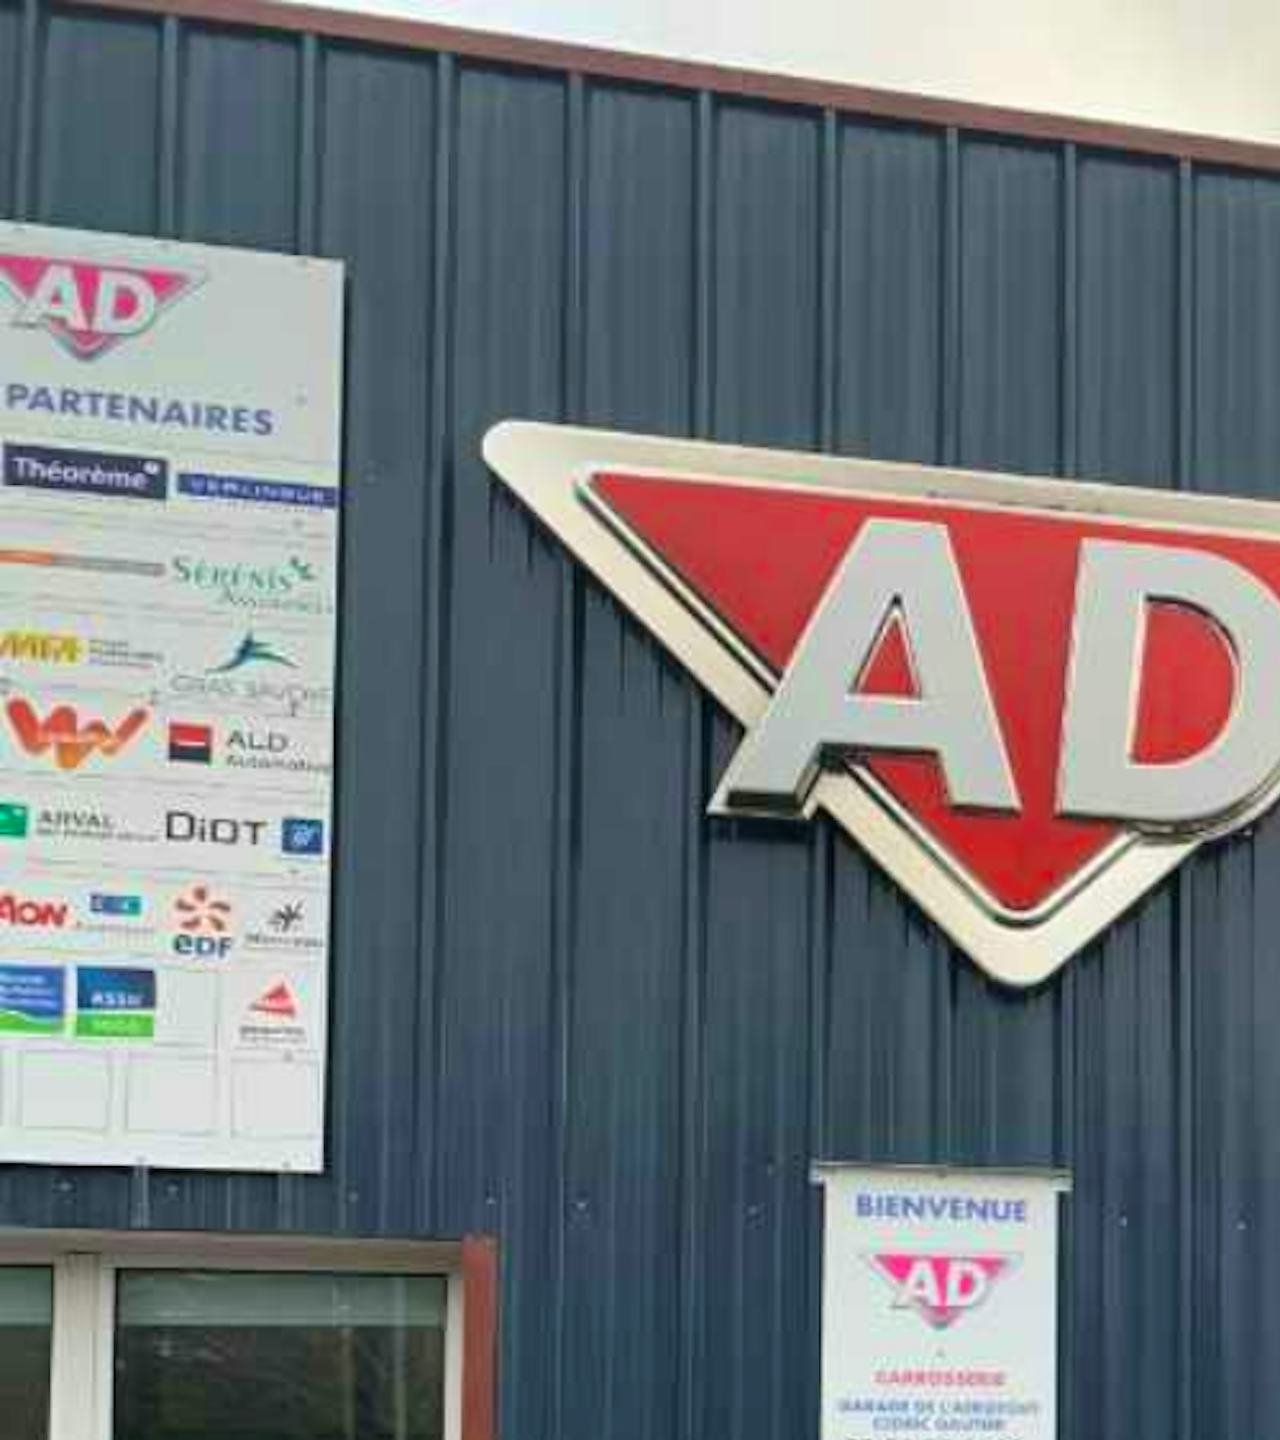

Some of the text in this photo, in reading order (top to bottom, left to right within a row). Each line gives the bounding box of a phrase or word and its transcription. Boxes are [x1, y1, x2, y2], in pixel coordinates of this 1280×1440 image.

[14, 263, 156, 334] AD
[5, 383, 274, 435] PARTENAIRES
[13, 456, 149, 489] Théorème
[226, 727, 289, 753] ALD
[856, 1193, 1027, 1222] BIENVENUE
[892, 1258, 990, 1308] AD
